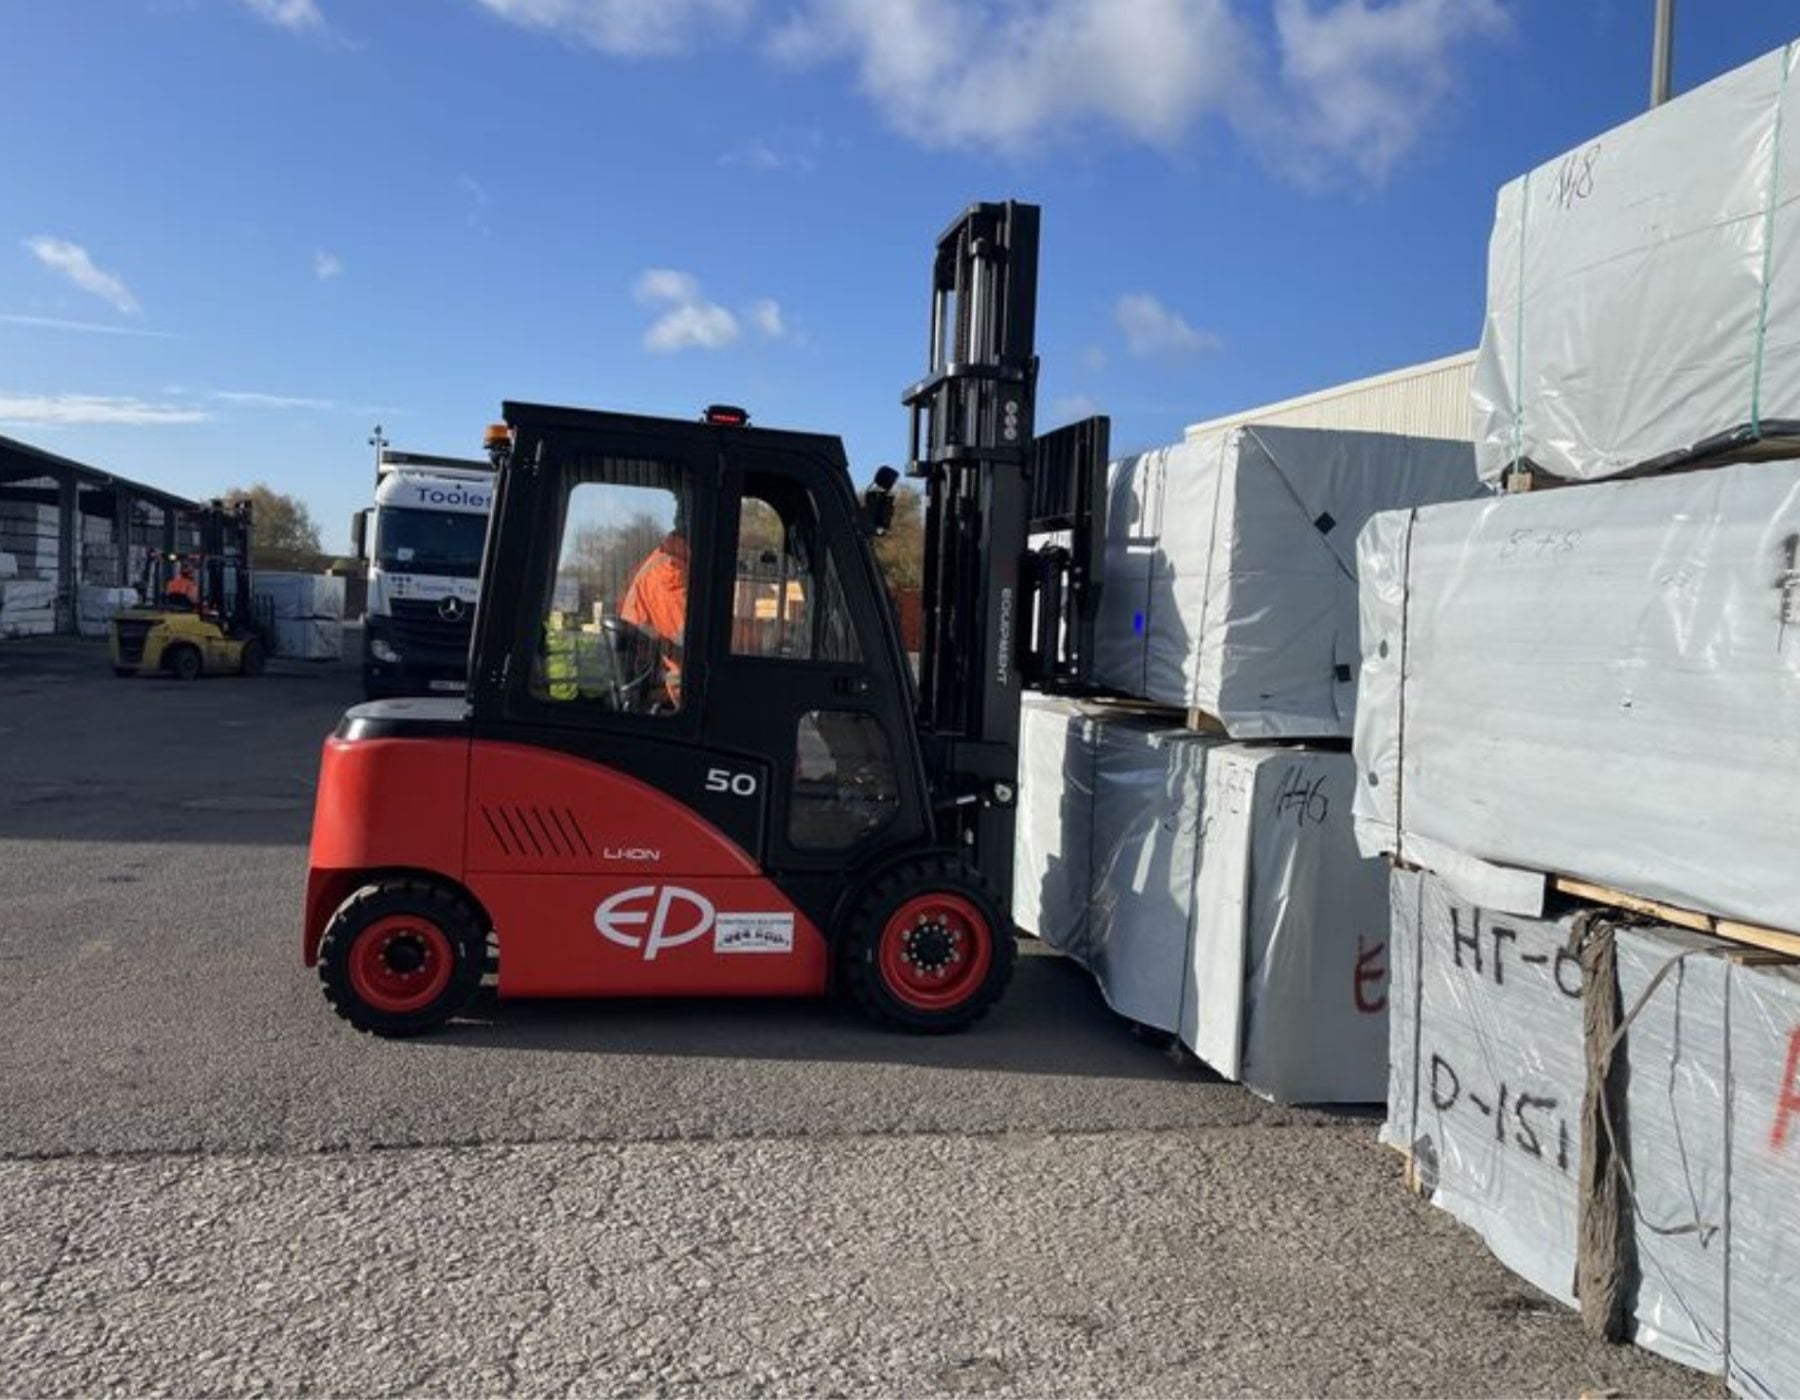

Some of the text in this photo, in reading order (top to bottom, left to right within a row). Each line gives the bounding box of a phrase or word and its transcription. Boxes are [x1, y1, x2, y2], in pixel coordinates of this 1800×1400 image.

[998, 588, 1012, 686] EQUIPMENT
[705, 768, 757, 796] 50
[594, 885, 716, 961] EP
[1432, 1052, 1568, 1170] D-151
